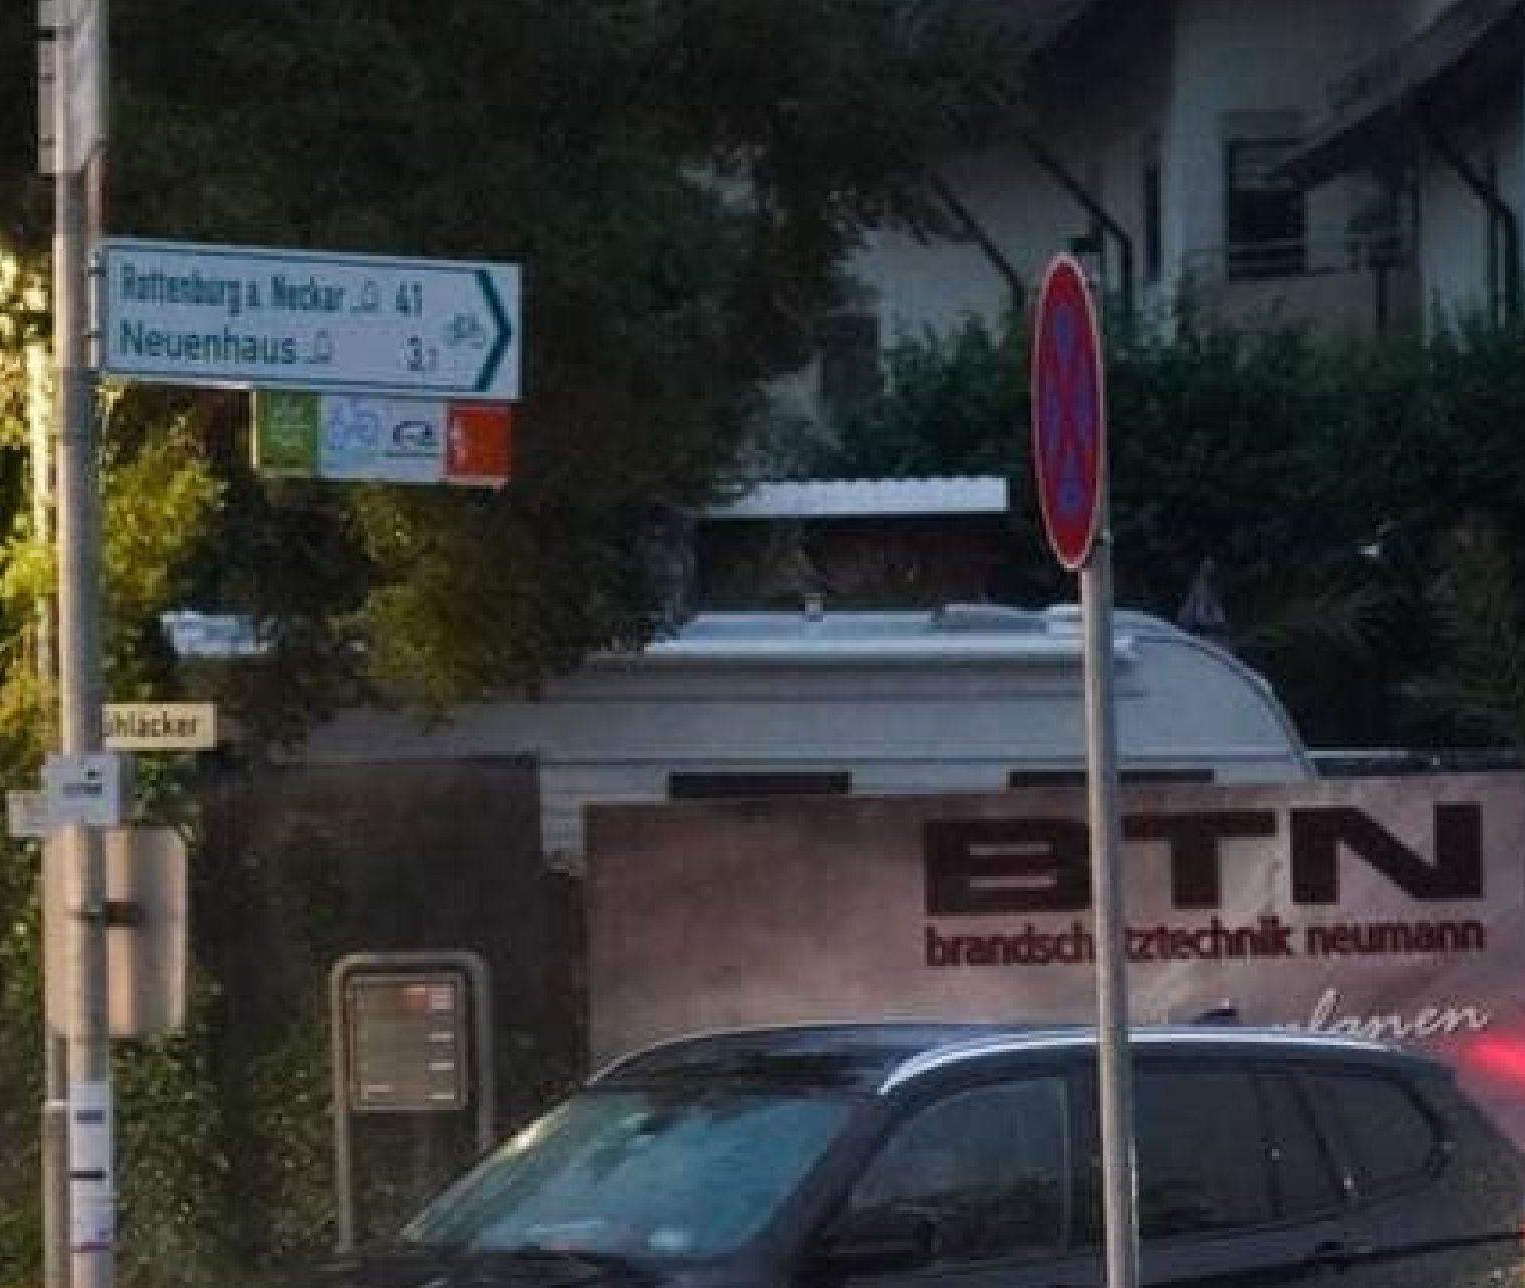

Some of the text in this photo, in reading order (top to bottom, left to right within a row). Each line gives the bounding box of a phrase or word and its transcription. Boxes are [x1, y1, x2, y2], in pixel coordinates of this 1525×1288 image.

[120, 319, 298, 365] Neuenhaus
[923, 803, 1486, 917] BTN
[924, 914, 1487, 968] brandschtztechnik neumann
